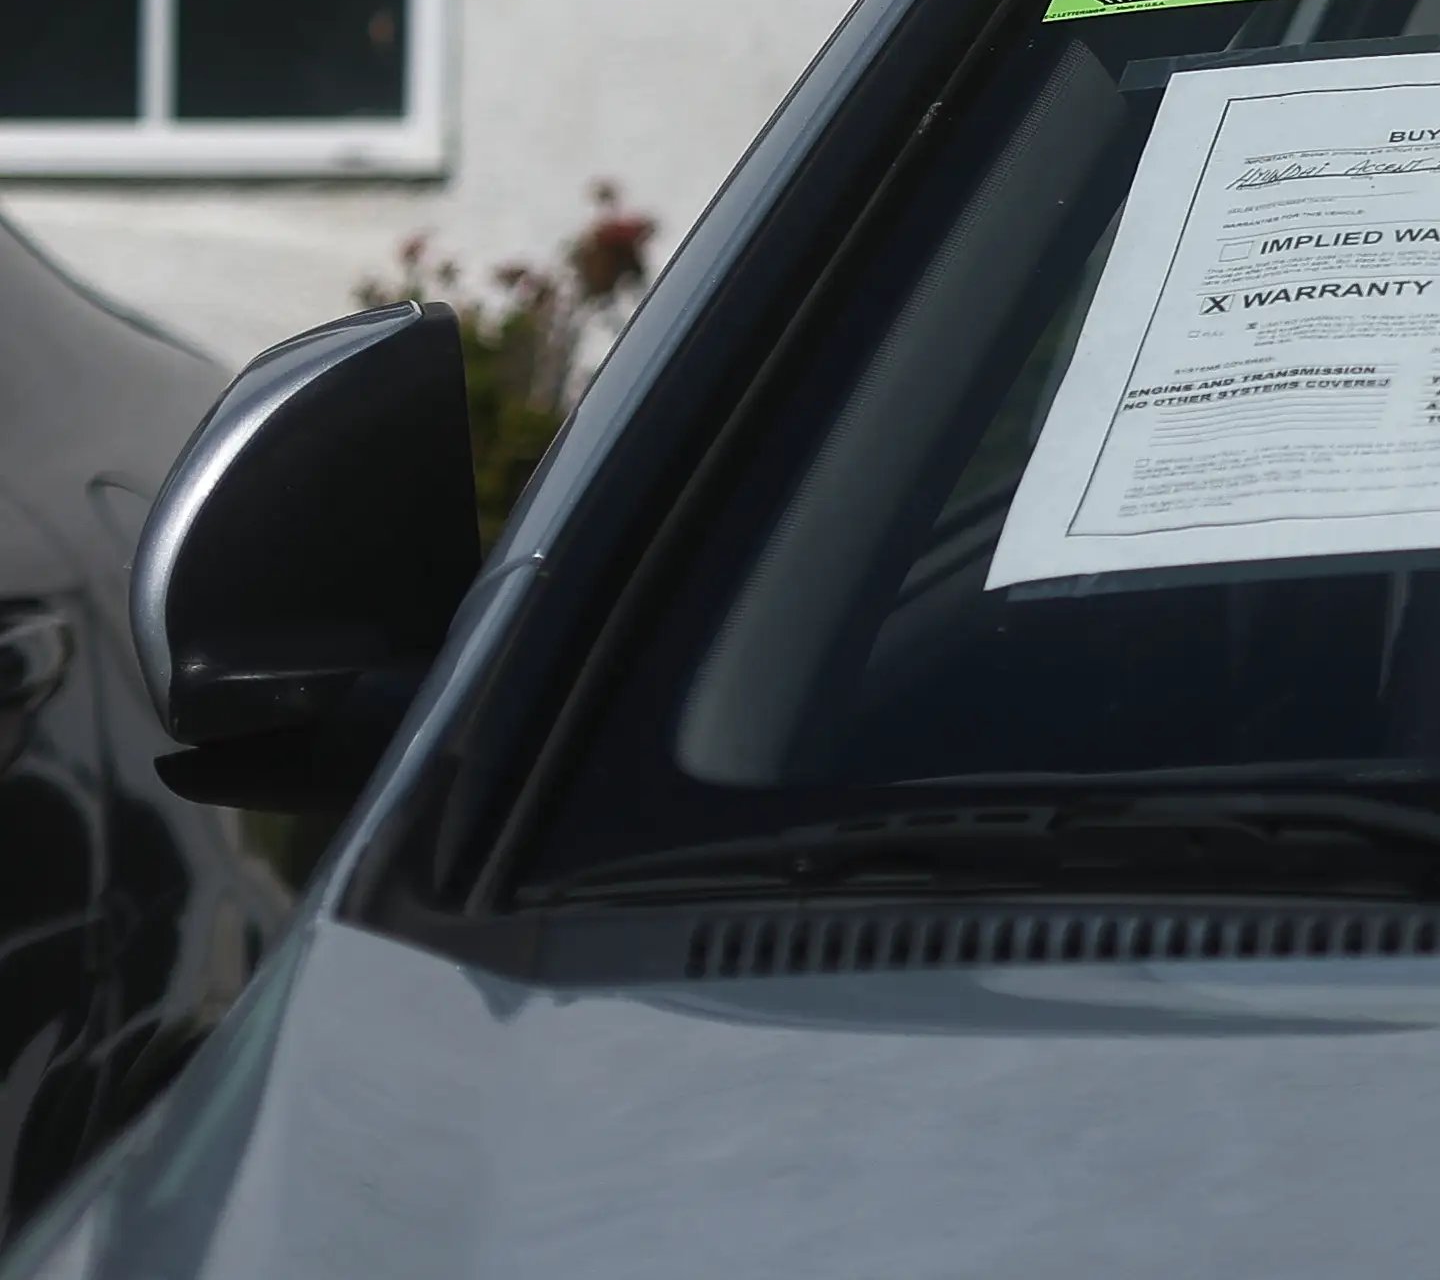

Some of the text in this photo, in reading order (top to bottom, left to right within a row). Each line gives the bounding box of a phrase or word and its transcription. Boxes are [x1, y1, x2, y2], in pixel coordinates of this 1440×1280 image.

[1260, 229, 1384, 256] IMPLIED
[1204, 280, 1434, 314] X WARRANTY
[1197, 377, 1235, 390] AND
[1240, 365, 1377, 383] TRANSMISSION
[1122, 401, 1148, 411] NO
[1152, 393, 1213, 407] OTHER
[1216, 380, 1299, 400] SYSTEMS
